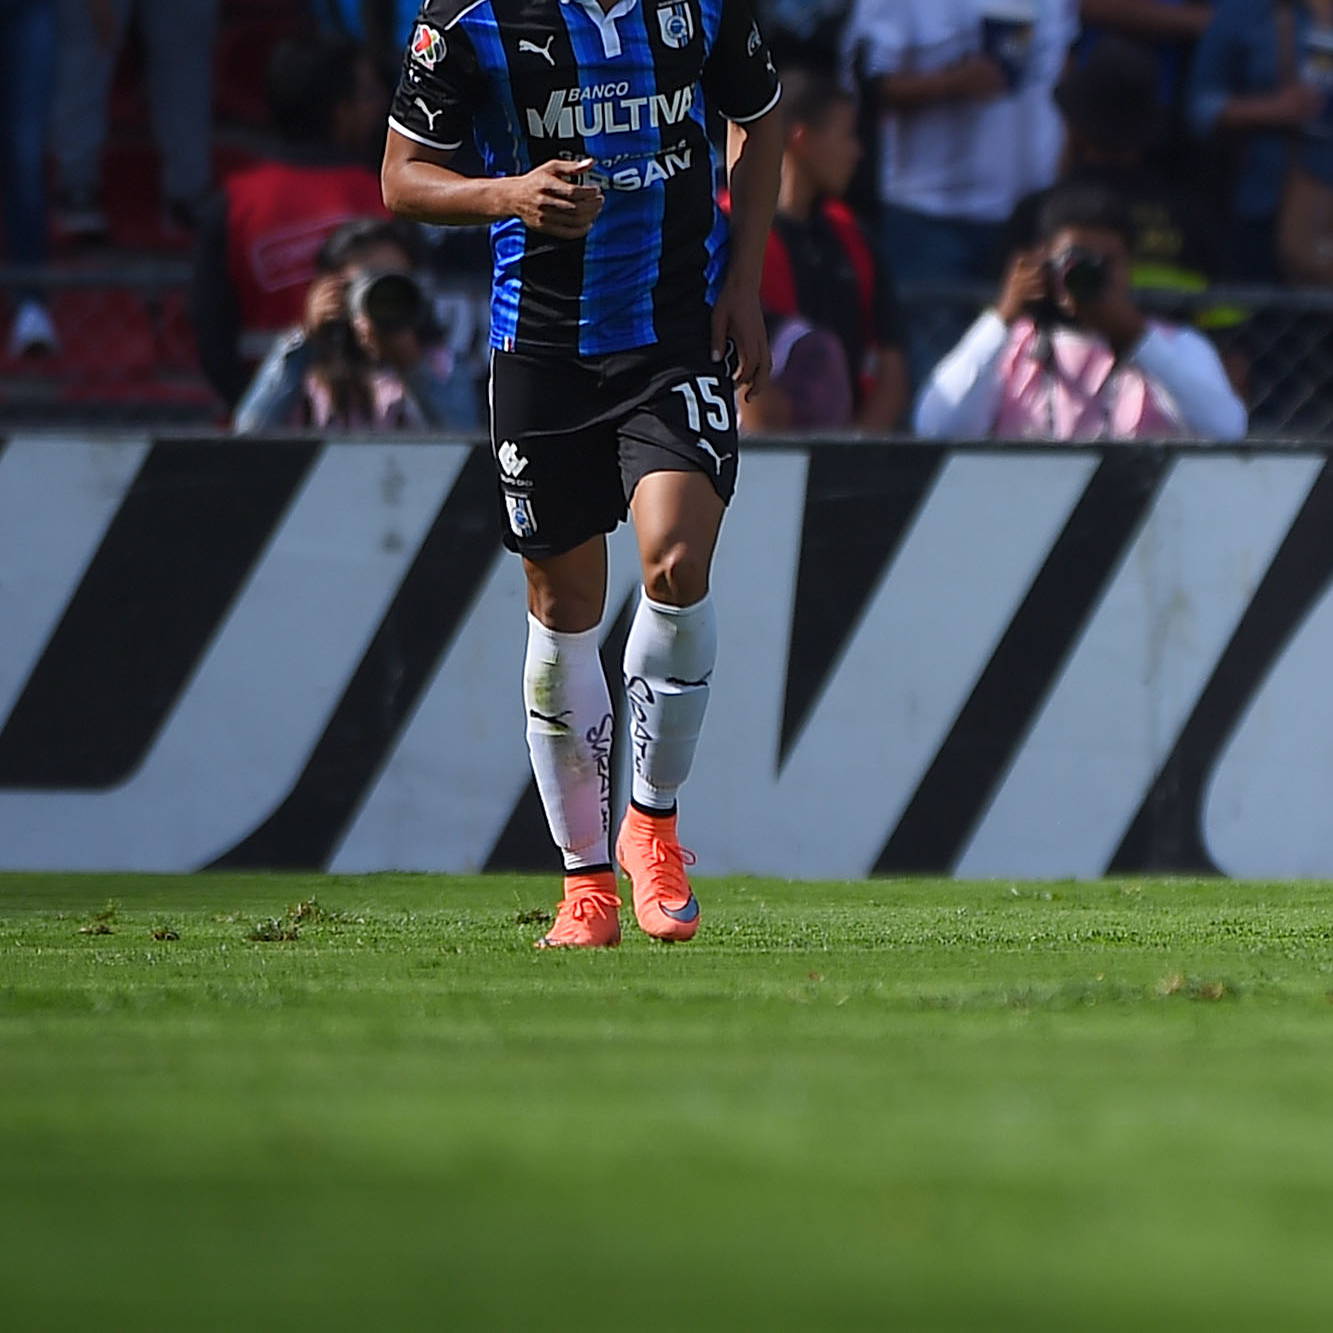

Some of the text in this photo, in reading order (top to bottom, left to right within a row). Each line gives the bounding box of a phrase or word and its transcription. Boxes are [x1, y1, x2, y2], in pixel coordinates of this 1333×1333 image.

[526, 84, 693, 139] MULTIVA
[568, 81, 629, 102] BANCO
[565, 149, 692, 192] RSAN
[671, 376, 730, 433] 15
